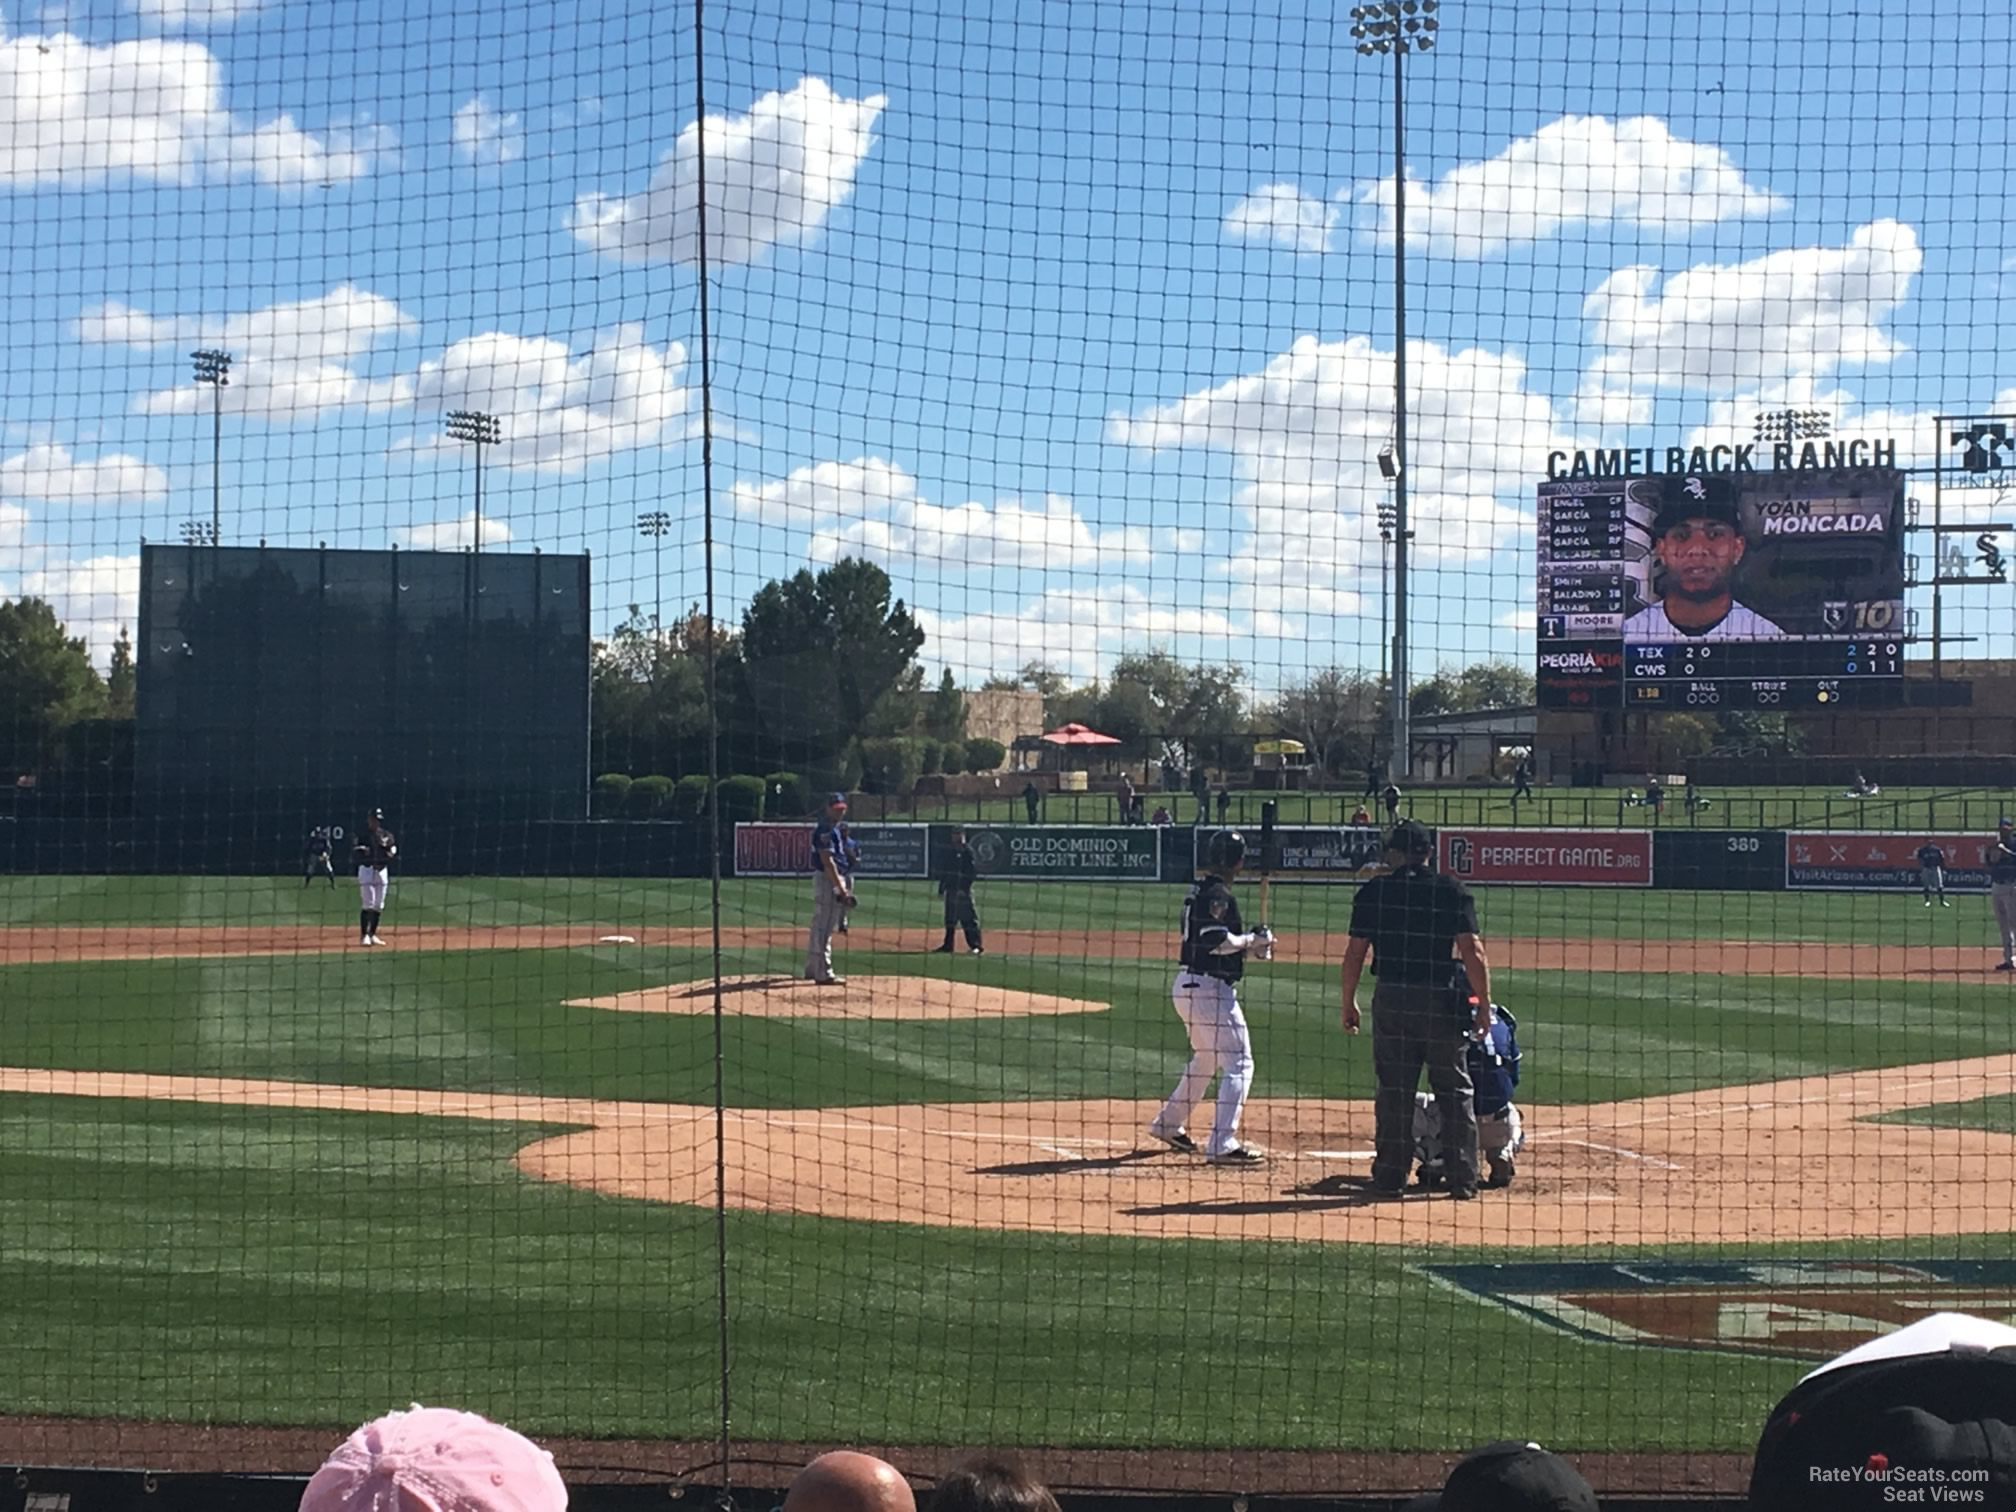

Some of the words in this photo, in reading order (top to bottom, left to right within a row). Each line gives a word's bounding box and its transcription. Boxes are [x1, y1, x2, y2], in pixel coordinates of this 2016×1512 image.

[1550, 444, 1754, 479] CAMELBACK
[1773, 438, 1896, 471] RANCH
[1763, 514, 1884, 535] MONCADA
[1574, 616, 1614, 625] MOORE
[1854, 600, 1892, 629] 10
[1543, 617, 1559, 636] T
[1637, 647, 1664, 659] TEX
[1686, 647, 1694, 658] 2
[1847, 645, 1857, 656] 2
[1867, 644, 1877, 655] 2
[1886, 644, 1897, 655] 0
[1540, 653, 1596, 668] PEORIA
[1634, 664, 1667, 676] CWS
[1869, 660, 1876, 673] 1
[1888, 660, 1895, 673] 1
[1691, 682, 1717, 692] BALL
[1751, 681, 1787, 691] STRIKE
[1817, 680, 1839, 690] OUT
[1010, 838, 1042, 852] OLD
[1046, 838, 1129, 853] DOMINION
[1727, 836, 1759, 852] 380
[1010, 853, 1077, 867] FREIGHT
[1481, 847, 1556, 866] PERFECT
